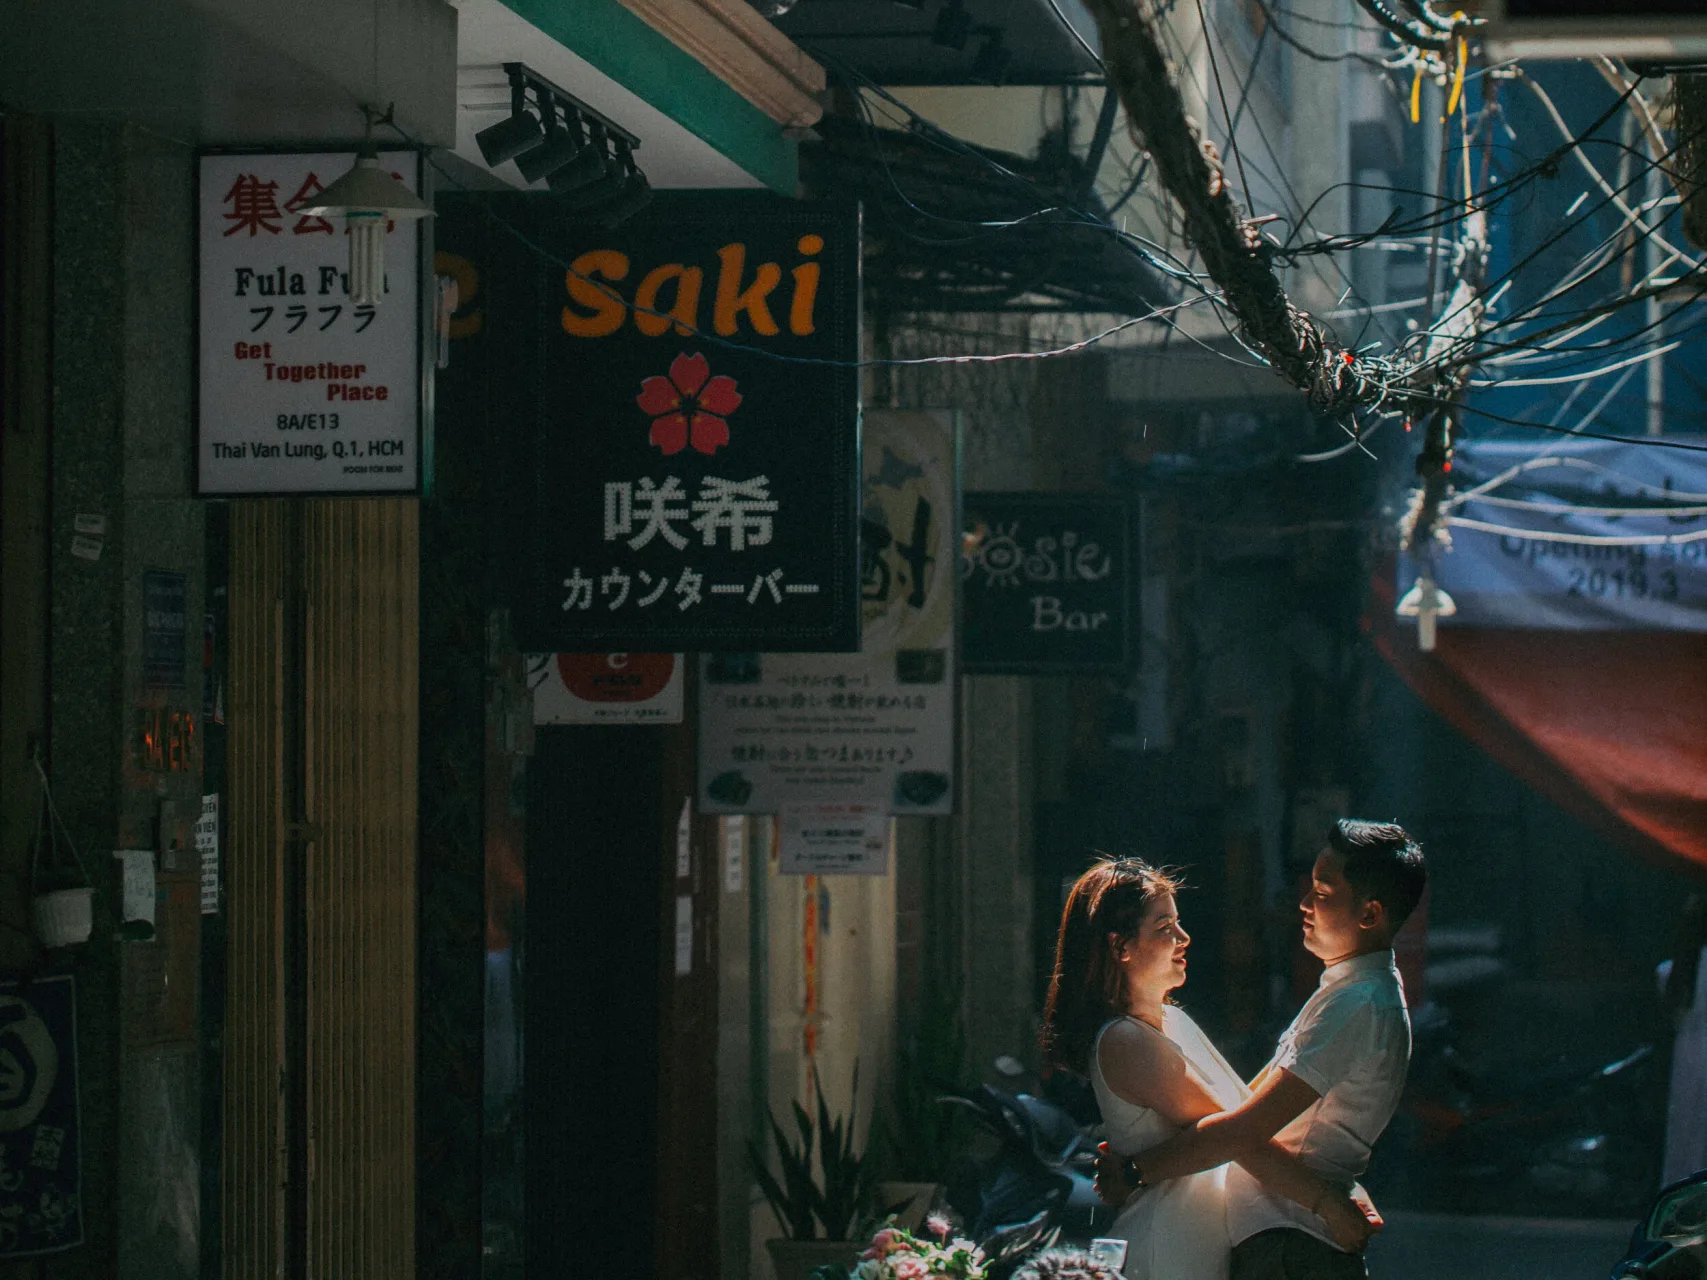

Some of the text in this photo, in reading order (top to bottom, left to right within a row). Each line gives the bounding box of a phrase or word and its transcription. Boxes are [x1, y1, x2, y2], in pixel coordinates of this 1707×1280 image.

[223, 170, 403, 237] 集会
[235, 266, 306, 297] Fula
[561, 234, 825, 339] Saki
[250, 304, 377, 335] フラフラ
[234, 341, 272, 360] Get
[264, 361, 366, 383] Together
[327, 382, 389, 402] Place
[276, 412, 340, 431] 8A/E13
[212, 439, 405, 461] Thai Van Lung, Q.1, HCM
[602, 474, 780, 552] 咲希
[561, 565, 820, 612] カウンターバー
[1030, 595, 1110, 632] Bar
